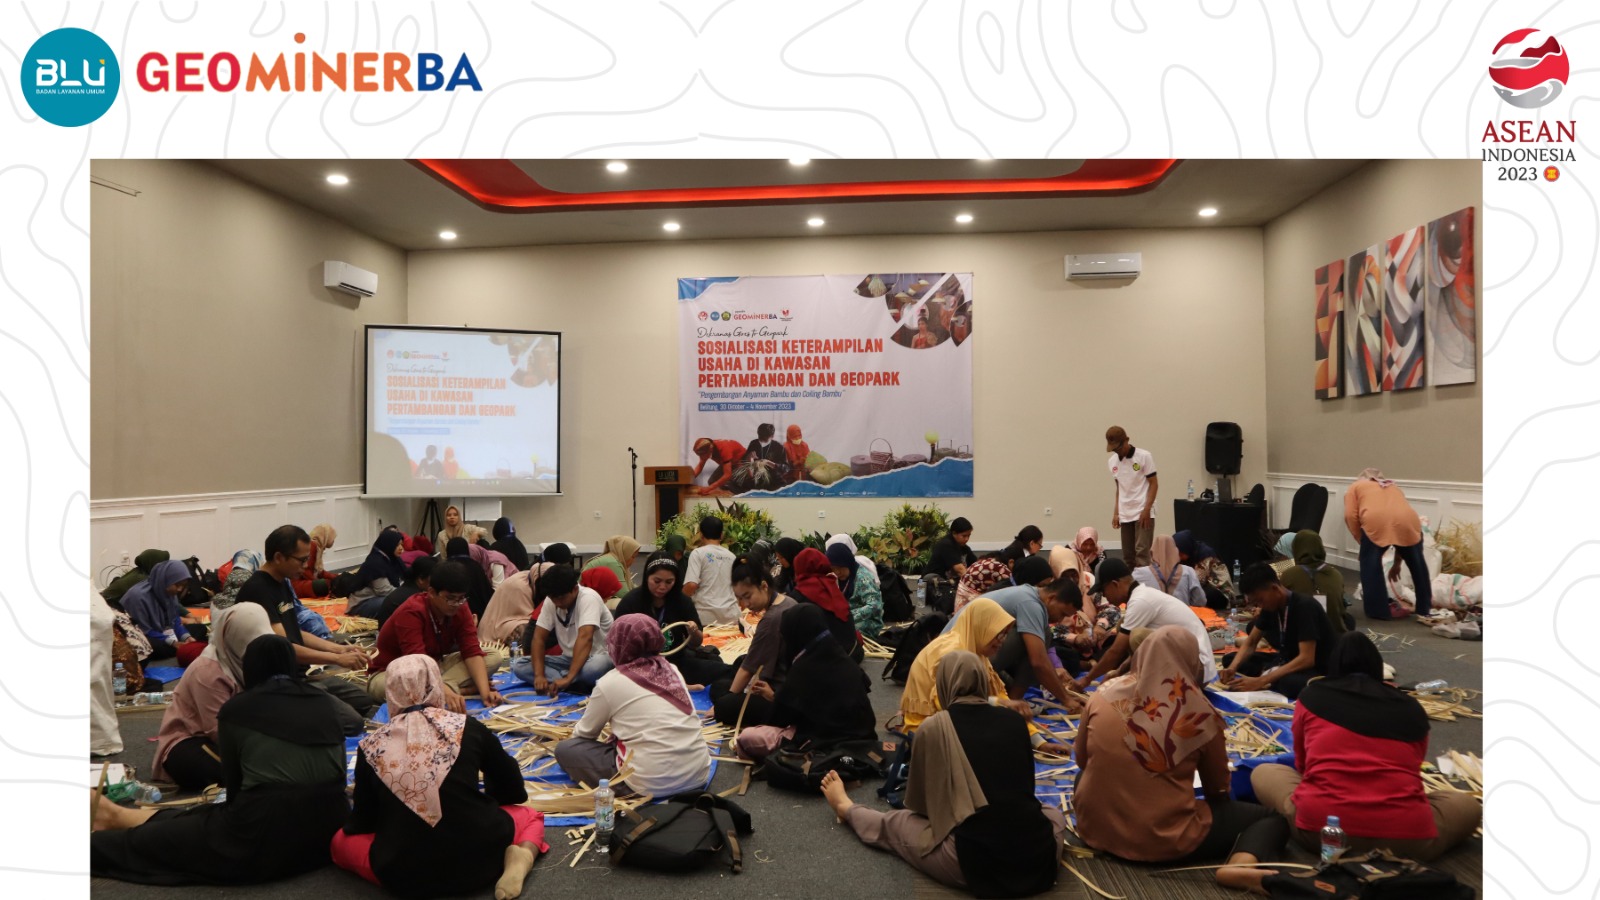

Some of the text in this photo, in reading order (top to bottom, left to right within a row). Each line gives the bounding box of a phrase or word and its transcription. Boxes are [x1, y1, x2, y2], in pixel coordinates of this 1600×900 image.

[697, 338, 883, 355] SOSIALISASI KETERAMPILAN
[698, 355, 831, 371] USAHA DI KAWASAN
[386, 375, 506, 390] SOSIALISASI KETERAMPILAN
[698, 371, 900, 388] PERTAMBANGAN DAN GEOPARK
[386, 389, 473, 402] USAHA DI KAWASAN
[743, 390, 768, 399] Anyaman
[770, 390, 789, 398] Bambu
[387, 403, 456, 416] PERTAMBANGAN
[458, 404, 476, 416] DAN
[755, 402, 778, 410] November
[778, 402, 792, 410] 2023
